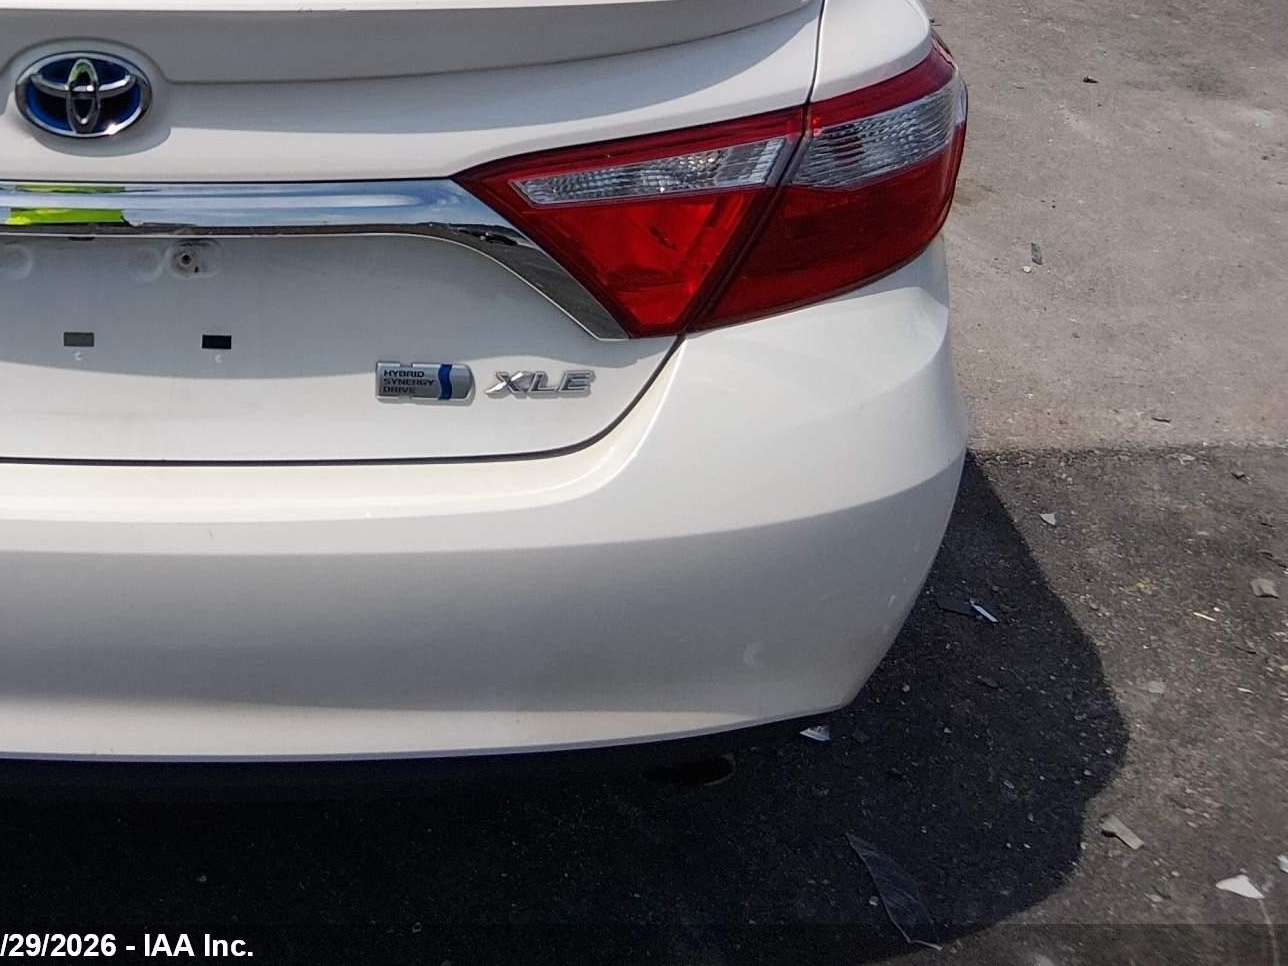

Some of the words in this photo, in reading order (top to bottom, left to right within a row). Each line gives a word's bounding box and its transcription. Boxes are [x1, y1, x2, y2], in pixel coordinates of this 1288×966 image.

[383, 369, 425, 378] HYBRID
[383, 377, 435, 387] SYNERGY
[485, 370, 596, 399] XLE
[383, 385, 416, 395] DRIVE
